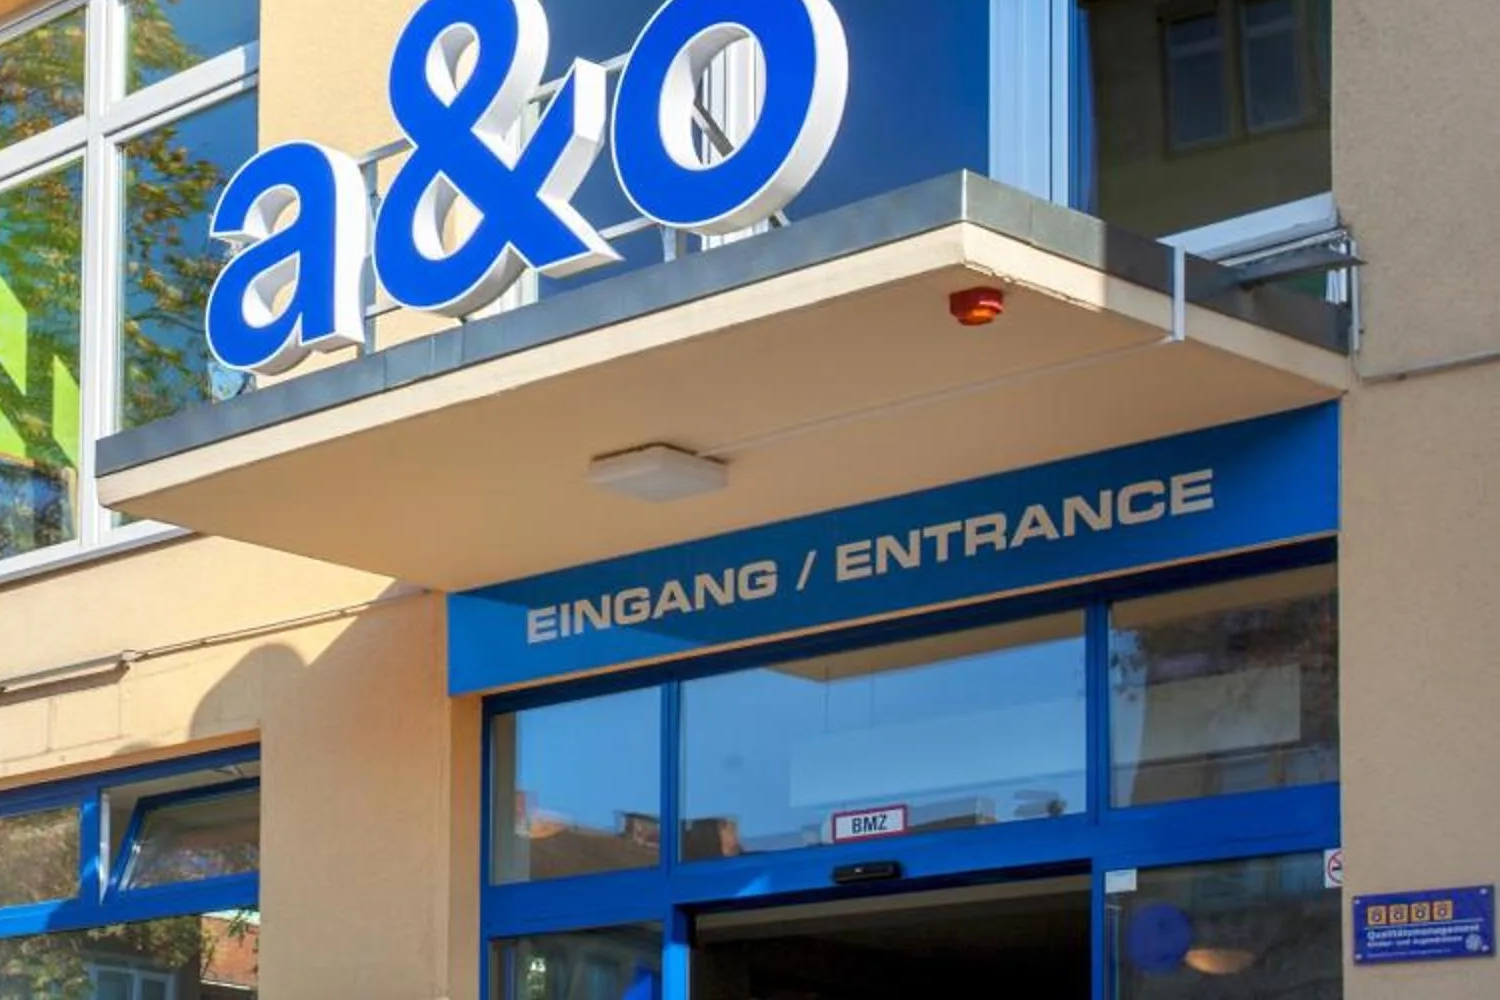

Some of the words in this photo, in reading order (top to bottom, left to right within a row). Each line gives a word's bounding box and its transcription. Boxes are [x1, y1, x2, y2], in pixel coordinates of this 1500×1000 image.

[526, 559, 778, 643] EINGANG
[796, 551, 816, 591] /
[836, 468, 1214, 581] ENTRANCE
[851, 813, 888, 834] BMZ
